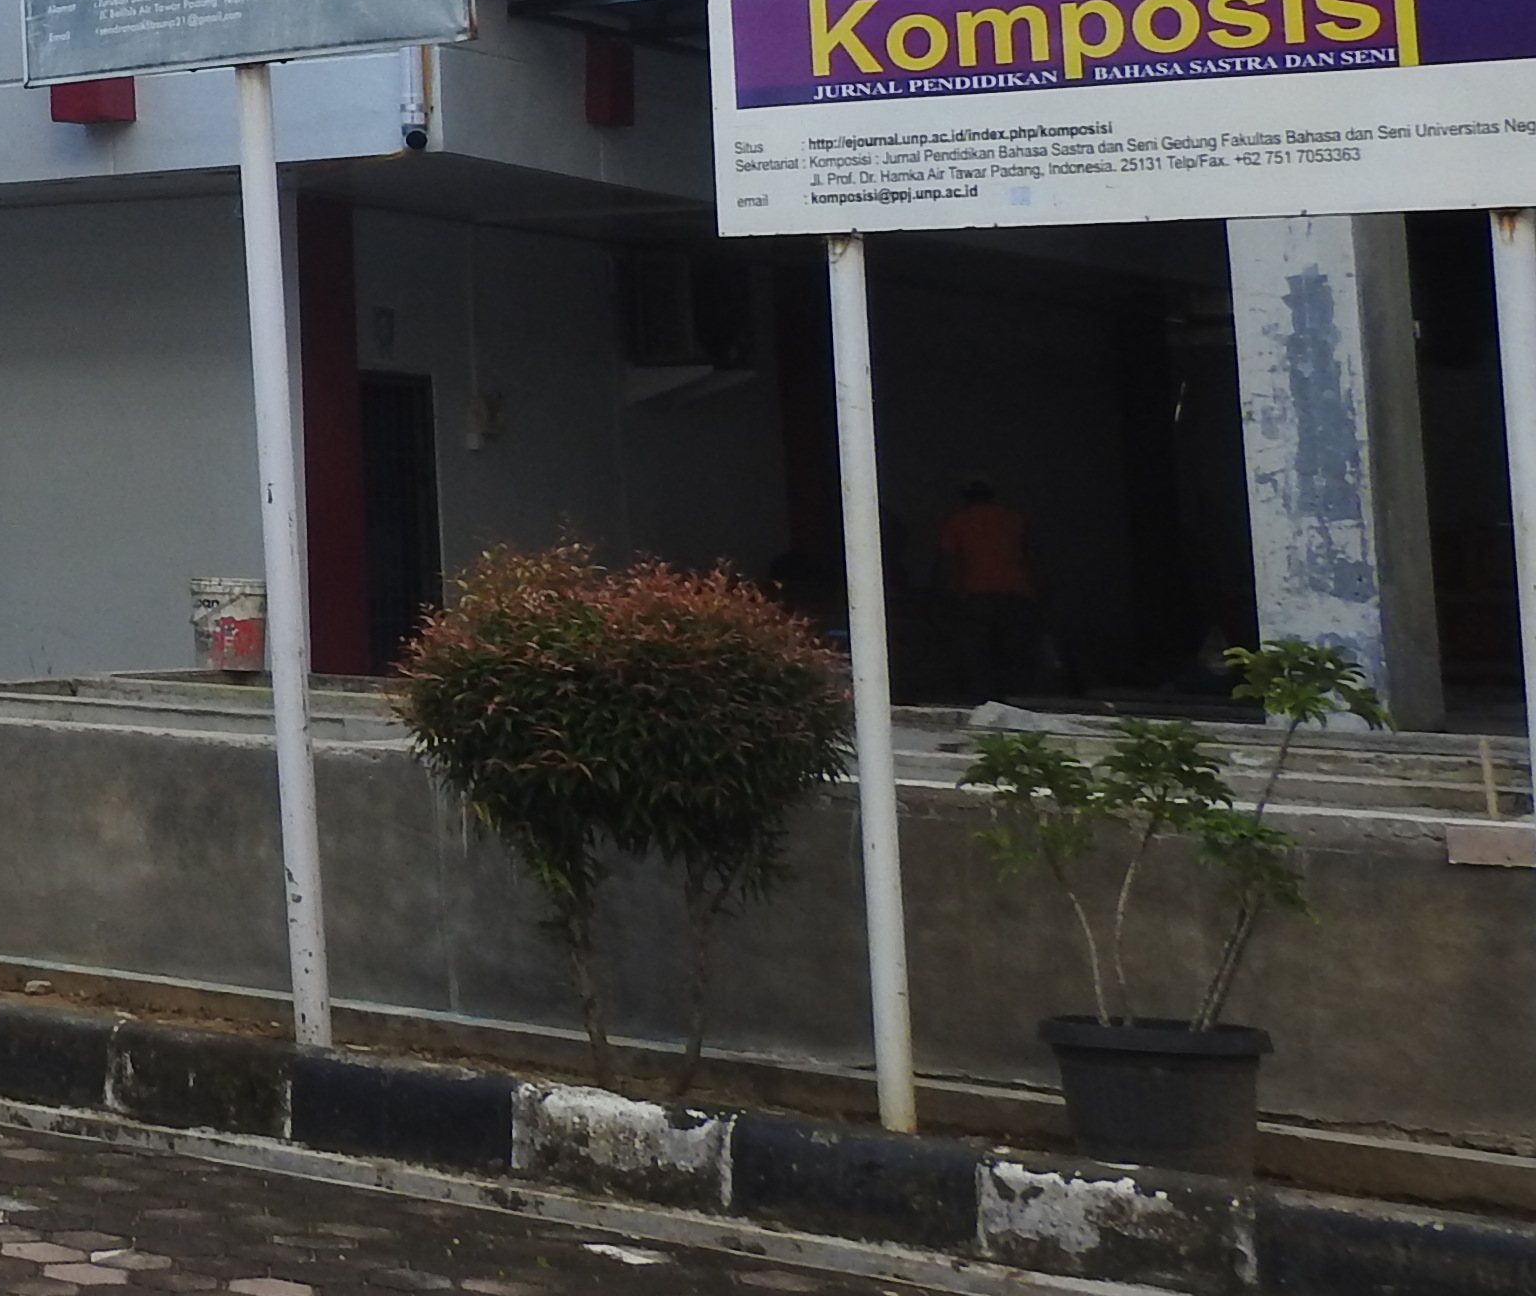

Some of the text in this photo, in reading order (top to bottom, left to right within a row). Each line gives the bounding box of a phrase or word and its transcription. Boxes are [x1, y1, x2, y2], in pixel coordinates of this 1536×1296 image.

[813, 47, 1398, 101] JURNAL PENDIDIKAN BAHASA SASTRA DAN SENI
[734, 141, 764, 155] Situs
[735, 157, 799, 172] Sekretariat
[809, 155, 871, 171] Komposisi
[881, 150, 920, 165] Jurnal
[924, 147, 995, 162] Pendidikan
[998, 144, 1048, 160] Bahasa
[1051, 142, 1095, 156] Sastra
[1097, 140, 1124, 154] dan
[1126, 137, 1158, 152] Seni
[1161, 134, 1218, 152] Gedung
[1221, 131, 1281, 147] Fakultas
[1285, 128, 1341, 145] Bahasa
[1345, 126, 1374, 142] dan
[1377, 124, 1412, 140] Seni
[1415, 120, 1500, 138] Universitas
[827, 171, 856, 185] Prof.
[859, 169, 876, 184] Dr.
[880, 168, 924, 183] Hamka
[927, 167, 945, 181] Air
[949, 164, 987, 179] Tawar
[1120, 156, 1162, 172] 25131
[1234, 152, 1261, 166] +62
[1266, 150, 1291, 165] 751
[1297, 147, 1361, 164] 7053363
[736, 185, 979, 208] email komposisi@ppj.unp.ac.id
